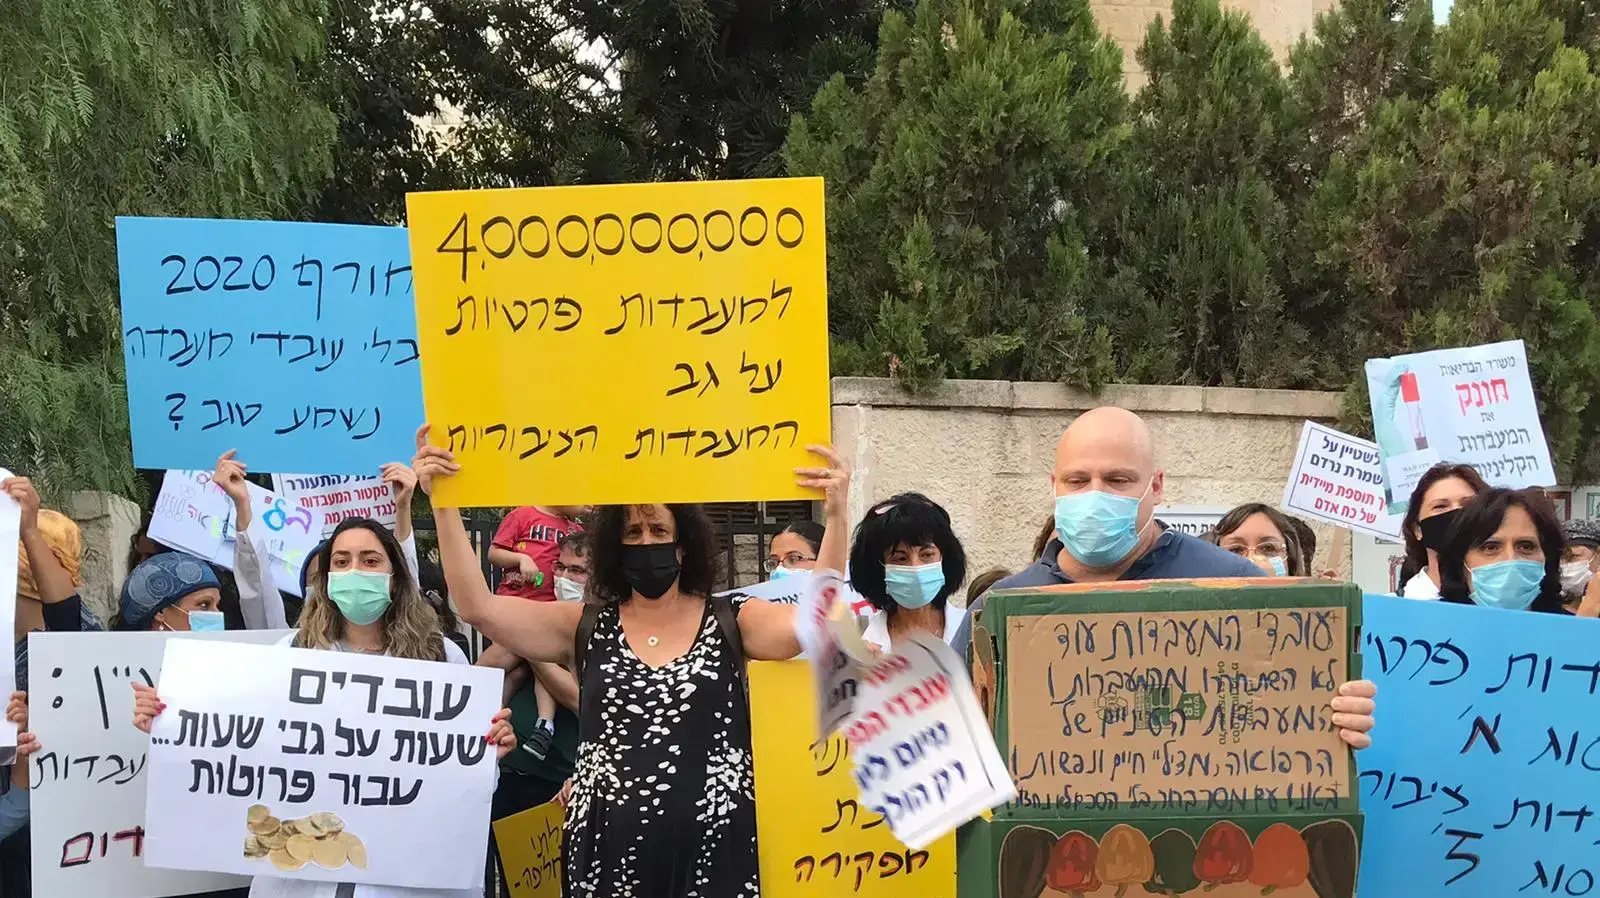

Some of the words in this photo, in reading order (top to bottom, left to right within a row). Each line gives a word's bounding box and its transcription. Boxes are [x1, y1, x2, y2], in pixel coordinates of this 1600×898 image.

[436, 206, 805, 283] 4,000,000,000
[161, 254, 276, 295] 2020
[292, 253, 412, 321] חורף
[445, 293, 583, 336] פרטיות
[604, 278, 793, 336] למעבדות
[126, 323, 234, 368] מעבדה
[250, 330, 344, 372] עובדי
[363, 326, 420, 366] בלי
[1486, 356, 1516, 371] משרד
[666, 360, 721, 398] גב
[739, 350, 783, 394] על
[1439, 361, 1483, 376] הבריאות
[201, 399, 262, 431] טוב
[1455, 378, 1509, 416] חונק
[274, 404, 381, 440] נשמע
[1480, 411, 1495, 422] את
[447, 422, 600, 460] הציבוריות
[624, 420, 800, 460] המעבדות
[1322, 435, 1339, 453] על
[1457, 428, 1531, 453] המעבדות
[1310, 453, 1342, 474] נרדם
[300, 490, 352, 508] המעבדות
[353, 484, 389, 501] סקטור
[1299, 472, 1334, 494] מיידית
[1335, 485, 1375, 506] תוספת
[1314, 497, 1340, 514] אדם
[1341, 505, 1357, 519] כח
[1359, 507, 1377, 524] של
[1054, 618, 1099, 660] עוד
[1101, 614, 1242, 662] המעבדות
[1256, 611, 1334, 656] עובדי
[1311, 658, 1338, 692] לא
[289, 667, 472, 721] עובדים
[1183, 697, 1194, 717] 18
[151, 708, 265, 750] שעות...
[1063, 699, 1092, 737] של
[277, 718, 325, 756] גבי
[334, 717, 381, 758] על
[390, 729, 487, 766] שעות
[188, 754, 316, 804] פרוטות
[1110, 750, 1145, 781] חיים
[328, 772, 424, 806] עבור
[1255, 785, 1279, 812] עם
[1518, 859, 1594, 896] סוג
